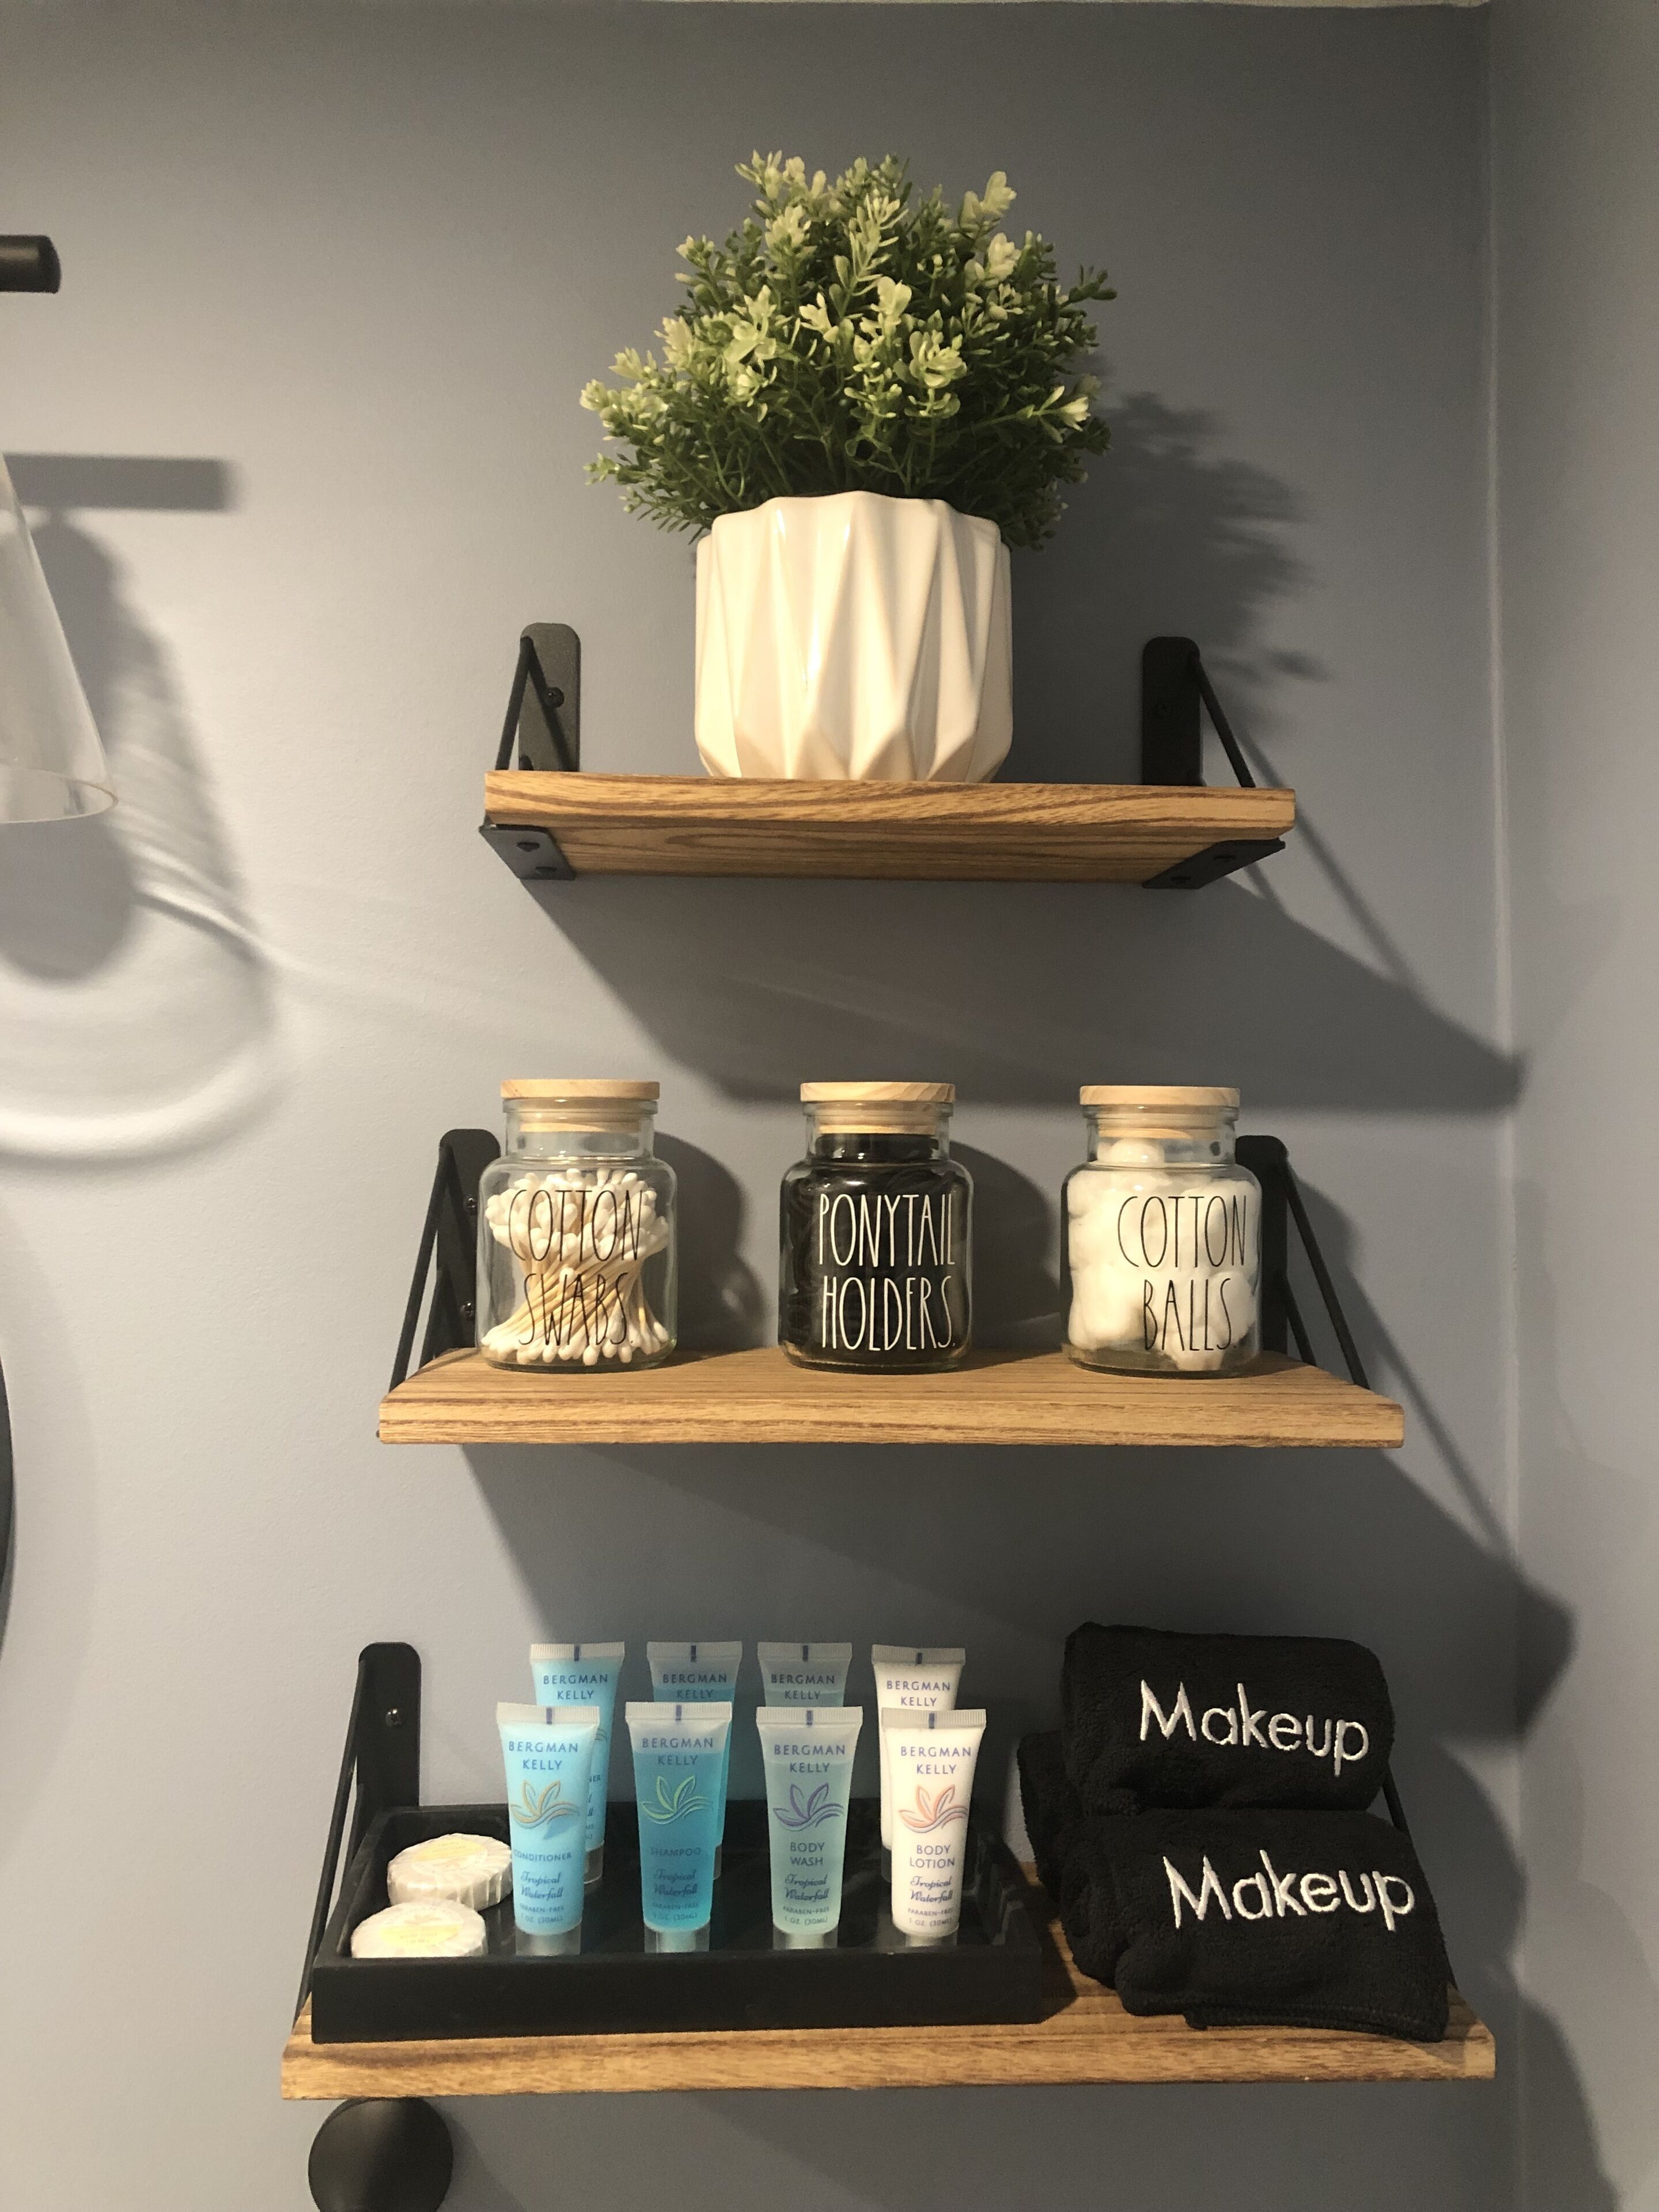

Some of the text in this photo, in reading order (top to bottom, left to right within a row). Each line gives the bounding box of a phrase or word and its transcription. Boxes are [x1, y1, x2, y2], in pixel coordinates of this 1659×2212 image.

[508, 1189, 643, 1262] COTTON
[819, 1193, 955, 1267] PONYTAIL
[1117, 1194, 1247, 1268] COTTON
[543, 1674, 608, 1685] BERGMAN
[662, 1674, 728, 1683] BERGMAN
[771, 1674, 835, 1684] BERGMAN
[886, 1680, 950, 1691] BERGMAN
[557, 1690, 594, 1700] KELLY
[676, 1689, 714, 1699] KELLY
[784, 1690, 821, 1700] KELLY
[900, 1697, 937, 1707] KELLY
[1139, 1679, 1369, 1777] Makeup
[508, 1741, 578, 1753] BERGMAN
[642, 1737, 714, 1748] BERGMAN
[774, 1744, 846, 1756] BERGMAN
[900, 1746, 972, 1758] BERGMAN
[522, 1759, 563, 1770] KELLY
[657, 1755, 699, 1766] KELLY
[789, 1762, 830, 1773] KELLY
[916, 1764, 957, 1775] KELLY
[650, 1847, 702, 1856] SHAMPOO
[790, 1842, 825, 1853] BODY
[916, 1844, 951, 1855] BODY
[513, 1849, 572, 1862] CONDITIONER
[790, 1856, 824, 1866] WASH
[910, 1857, 956, 1869] LOTION
[520, 1870, 562, 1887] Tropical
[785, 1873, 828, 1889] Tropical
[910, 1875, 952, 1891] Tropical
[521, 1884, 564, 1901] Waterfall
[784, 1887, 830, 1903] Waterfall
[910, 1889, 953, 1903] Waterfall
[1162, 1849, 1415, 1932] Makeup
